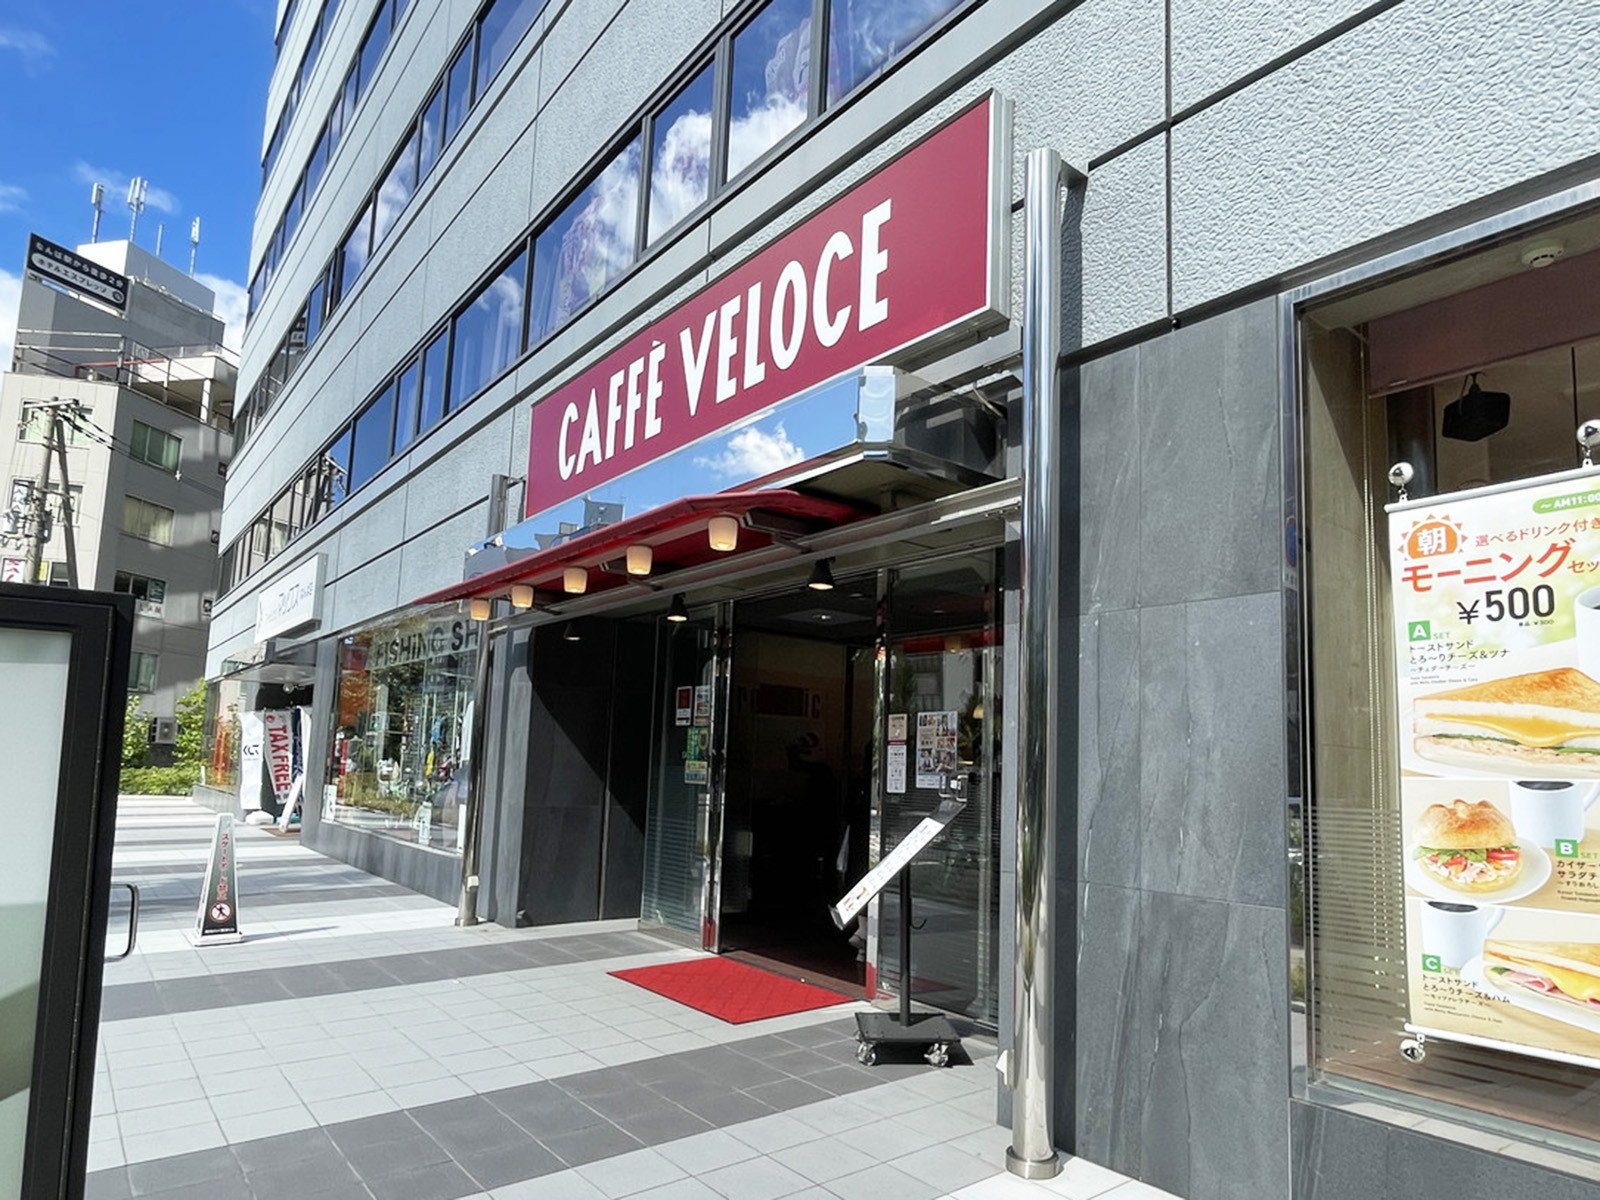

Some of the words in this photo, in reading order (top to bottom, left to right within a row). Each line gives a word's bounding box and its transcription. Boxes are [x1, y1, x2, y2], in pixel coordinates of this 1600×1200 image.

[558, 340, 666, 481] CAFFÈ
[679, 198, 892, 417] VELOCE
[1417, 526, 1447, 555] 朝
[1456, 584, 1555, 625] ¥500
[1409, 640, 1473, 653] トーストサンド
[1412, 624, 1426, 639] A
[1433, 632, 1450, 640] SET
[268, 725, 289, 754] TAX
[272, 755, 291, 792] FREE
[1560, 842, 1573, 855] B
[1425, 957, 1438, 970] C
